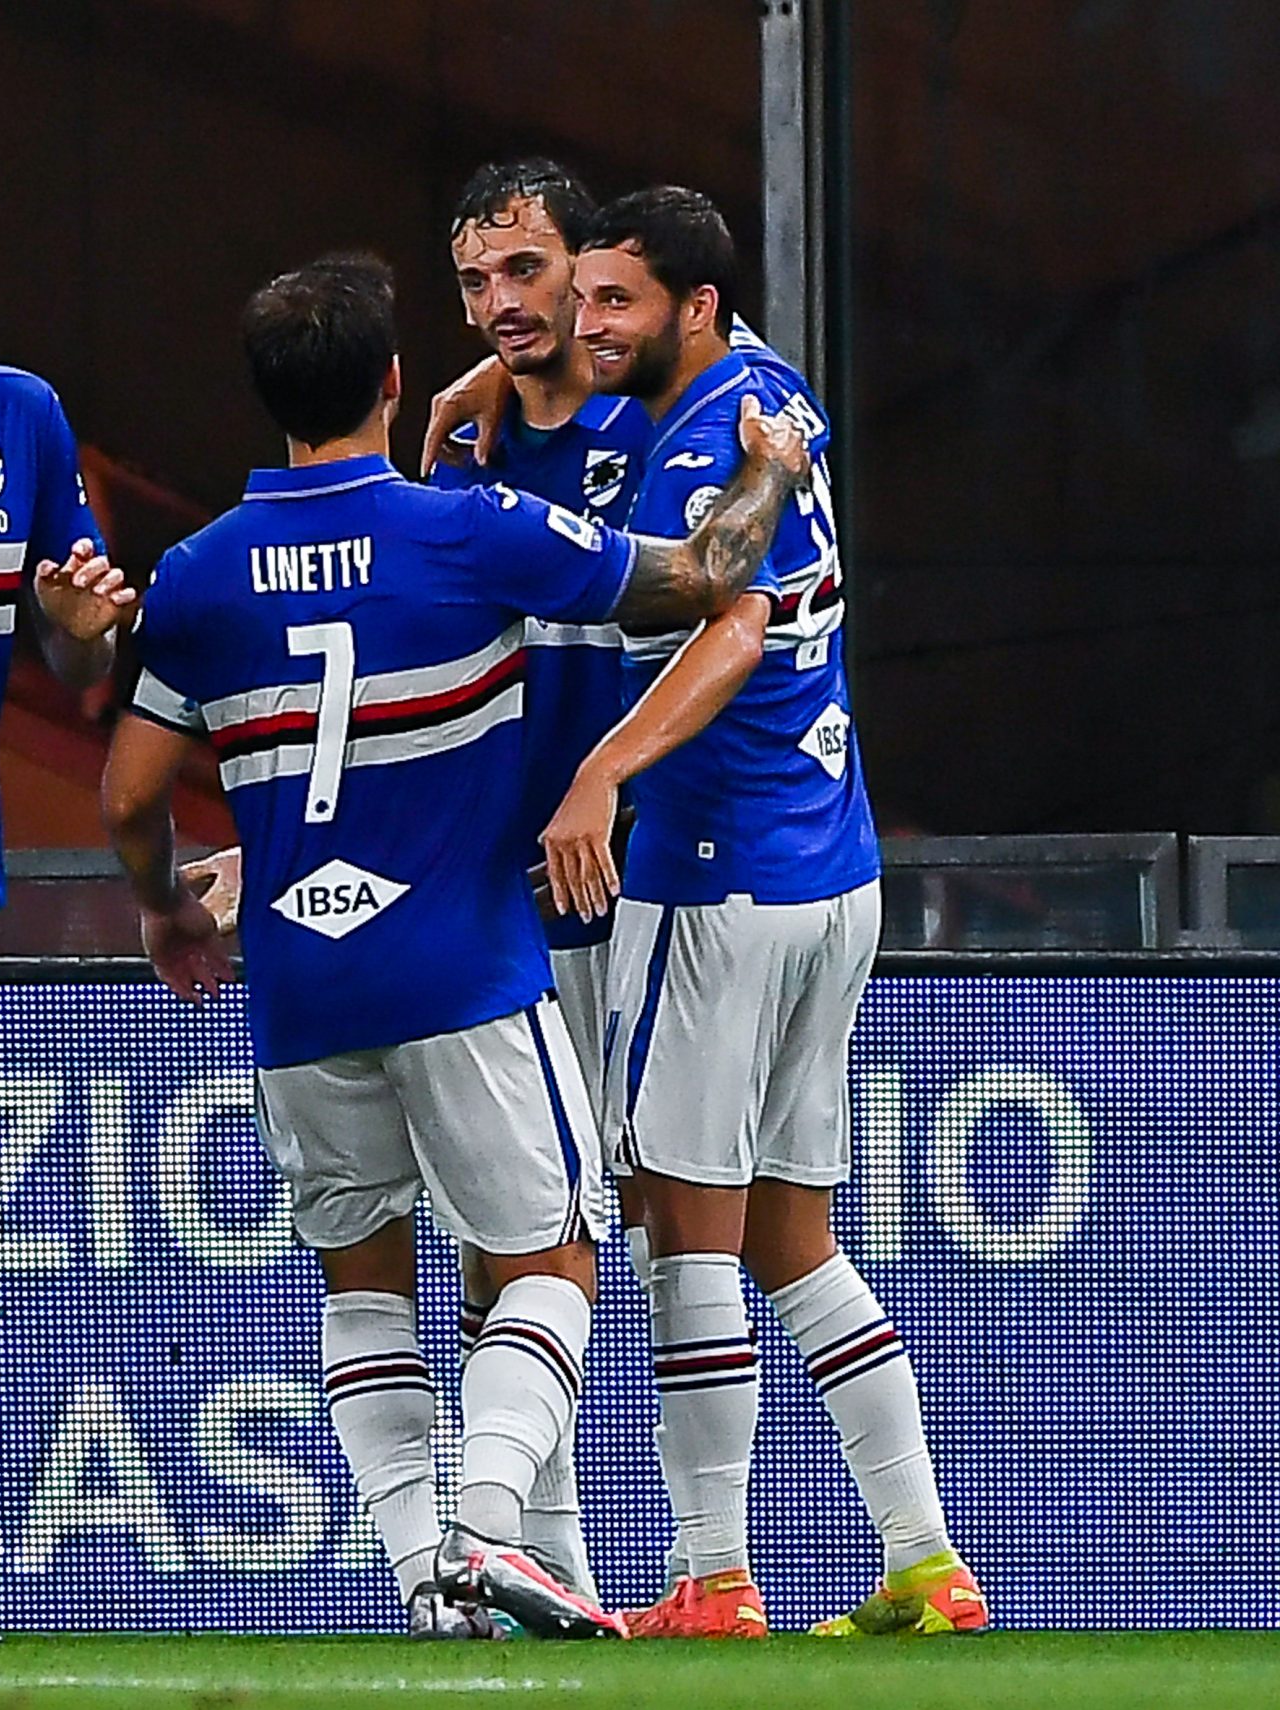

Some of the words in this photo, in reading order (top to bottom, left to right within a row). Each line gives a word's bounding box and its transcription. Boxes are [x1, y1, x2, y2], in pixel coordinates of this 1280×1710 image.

[249, 535, 373, 594] LINETTY
[285, 621, 355, 824] 7
[295, 882, 381, 917] IBSA
